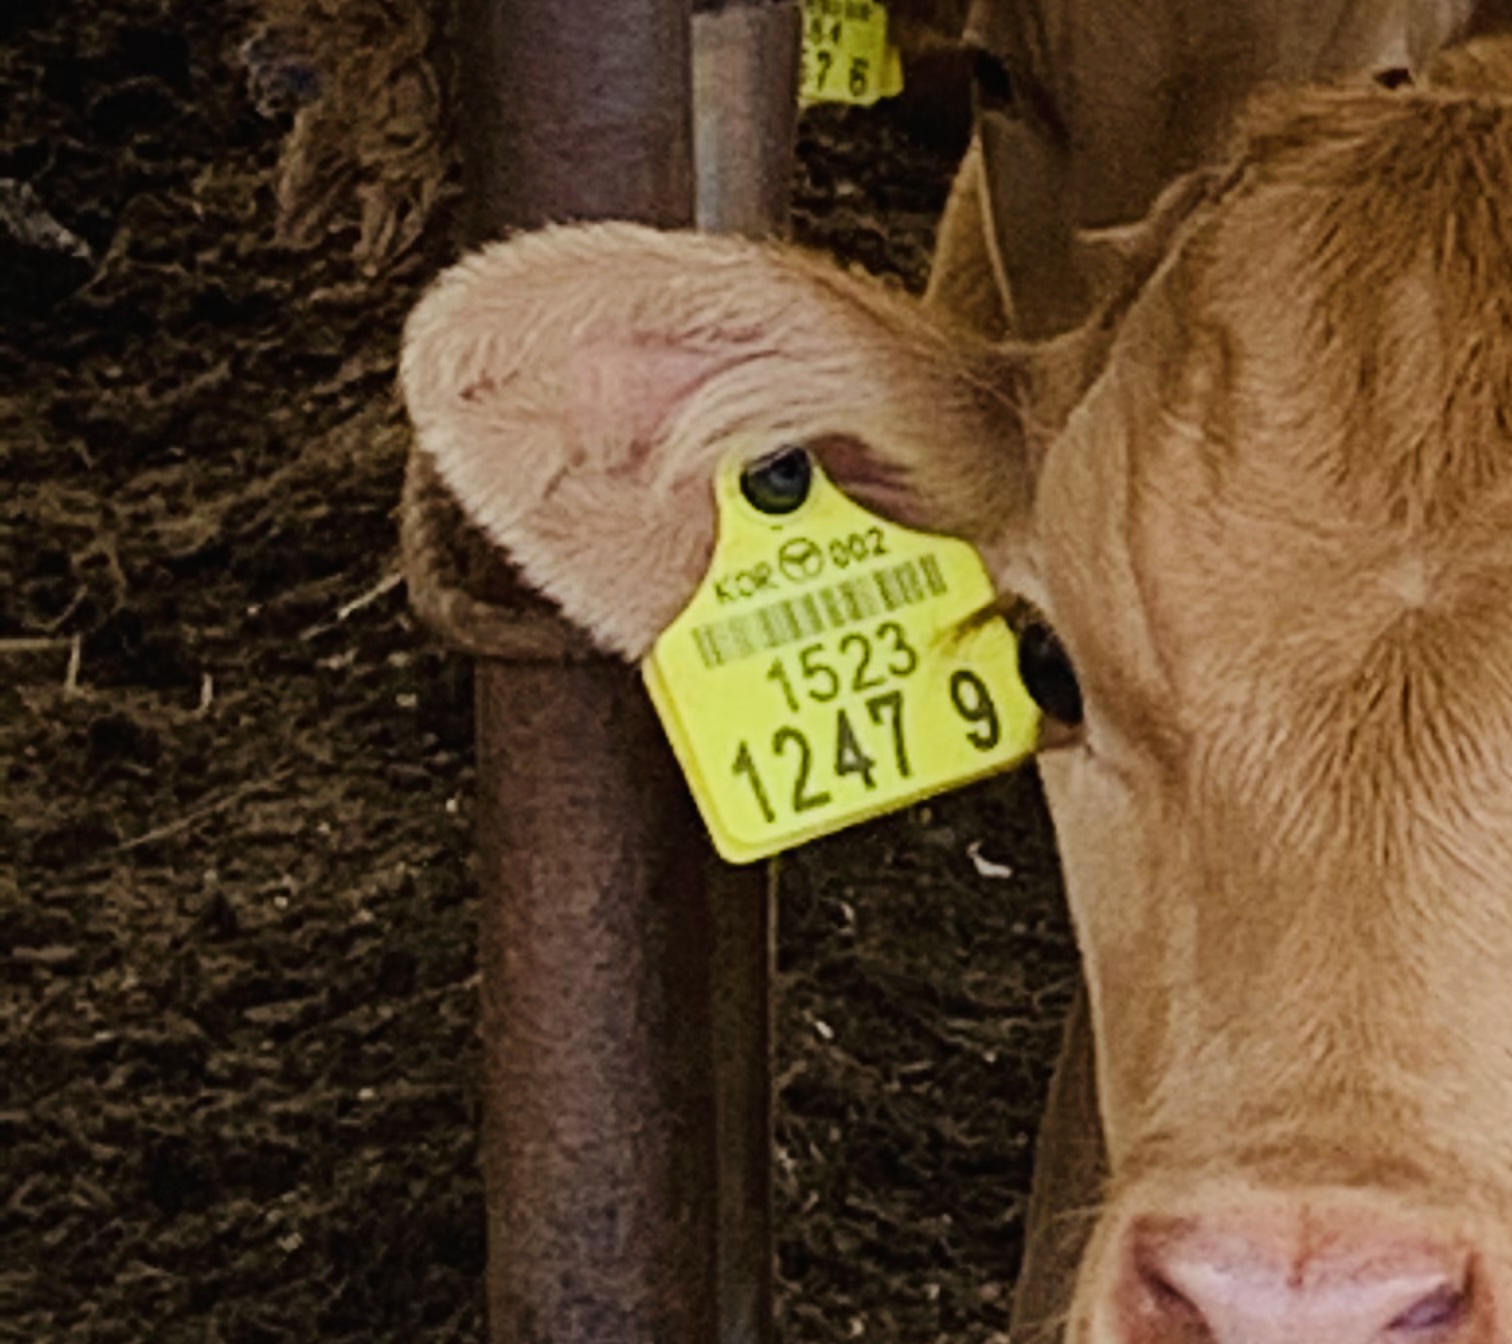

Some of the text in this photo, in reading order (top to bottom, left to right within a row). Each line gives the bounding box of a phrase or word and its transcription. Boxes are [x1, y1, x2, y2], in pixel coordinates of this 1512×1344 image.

[714, 527, 889, 604] KOR 002
[767, 621, 919, 713] 1523
[732, 668, 1000, 824] 1247 9
